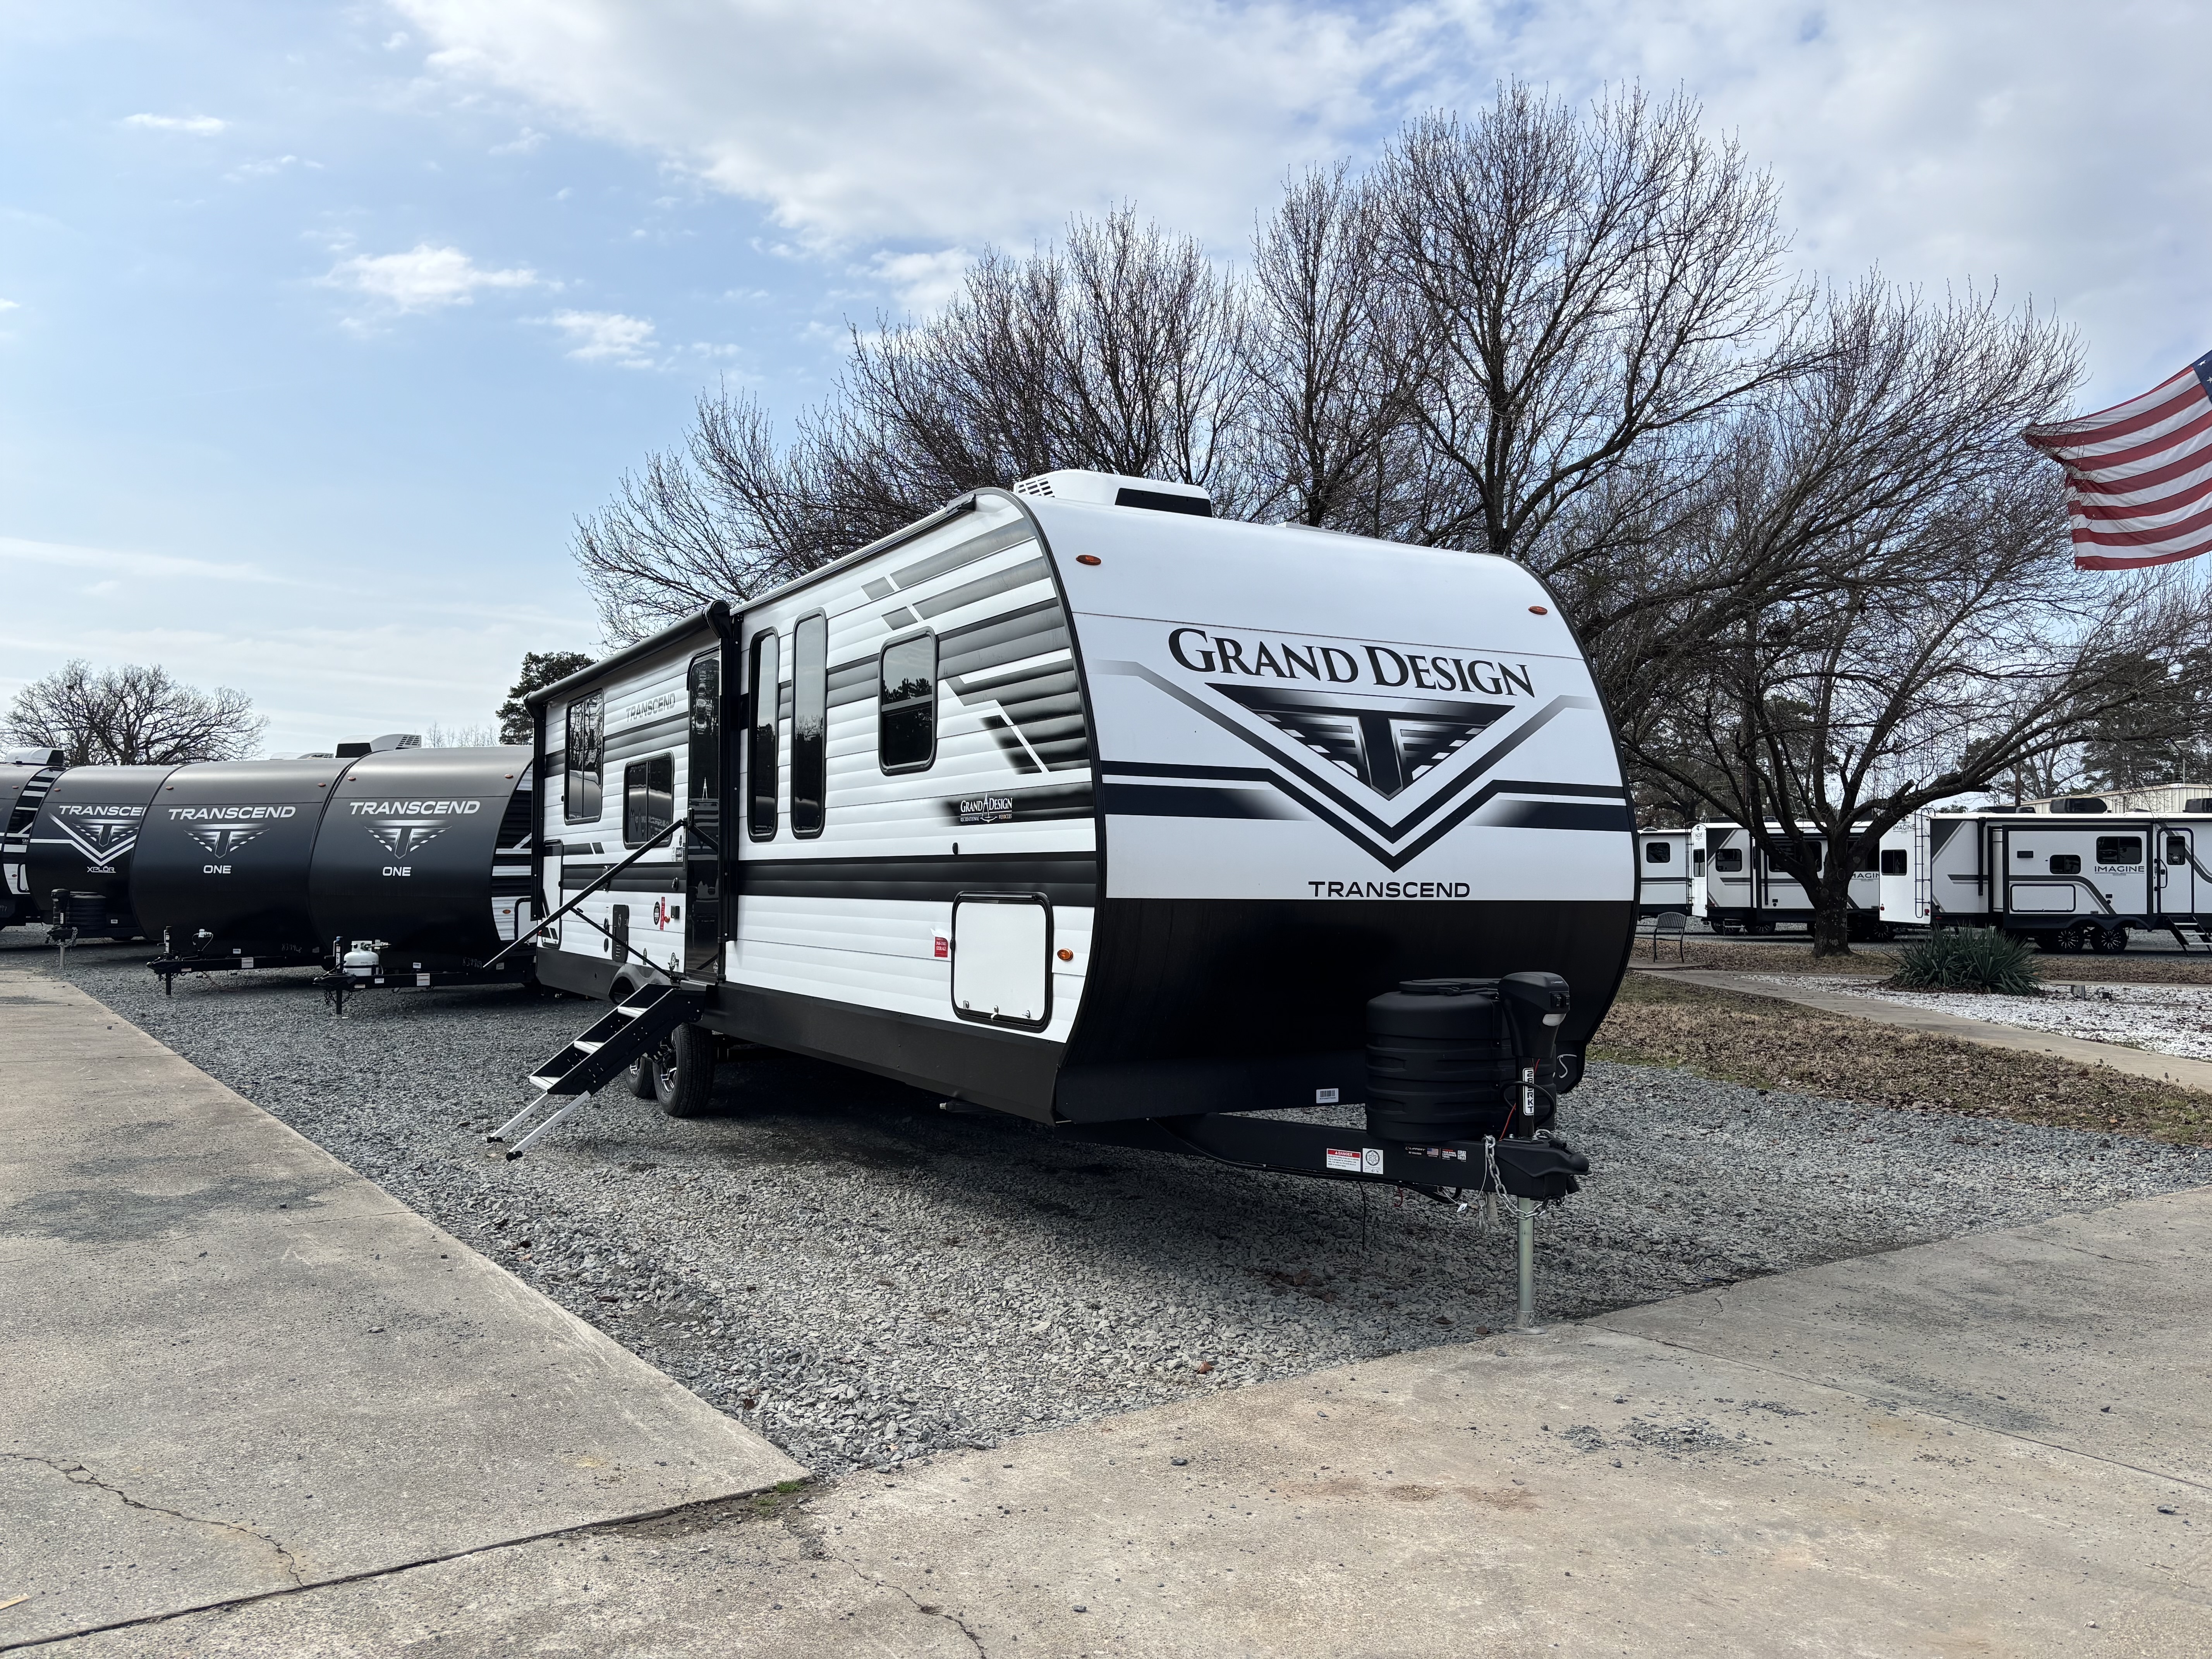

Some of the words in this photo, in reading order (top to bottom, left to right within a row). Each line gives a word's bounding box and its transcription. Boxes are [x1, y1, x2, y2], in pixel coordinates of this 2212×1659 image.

[1168, 627, 1358, 683] GRAND
[1359, 645, 1535, 698] DESIGN
[626, 692, 676, 723] TRANSCEND
[59, 805, 146, 816] TRANSCE
[349, 800, 481, 815] TRANSCEND
[960, 800, 983, 813] GRAND
[989, 797, 1013, 811] DESIGN
[168, 806, 296, 820] TRANSCEND
[203, 865, 232, 874] ONE
[382, 866, 412, 877] ONE
[1308, 881, 1470, 898] TRANSCEND
